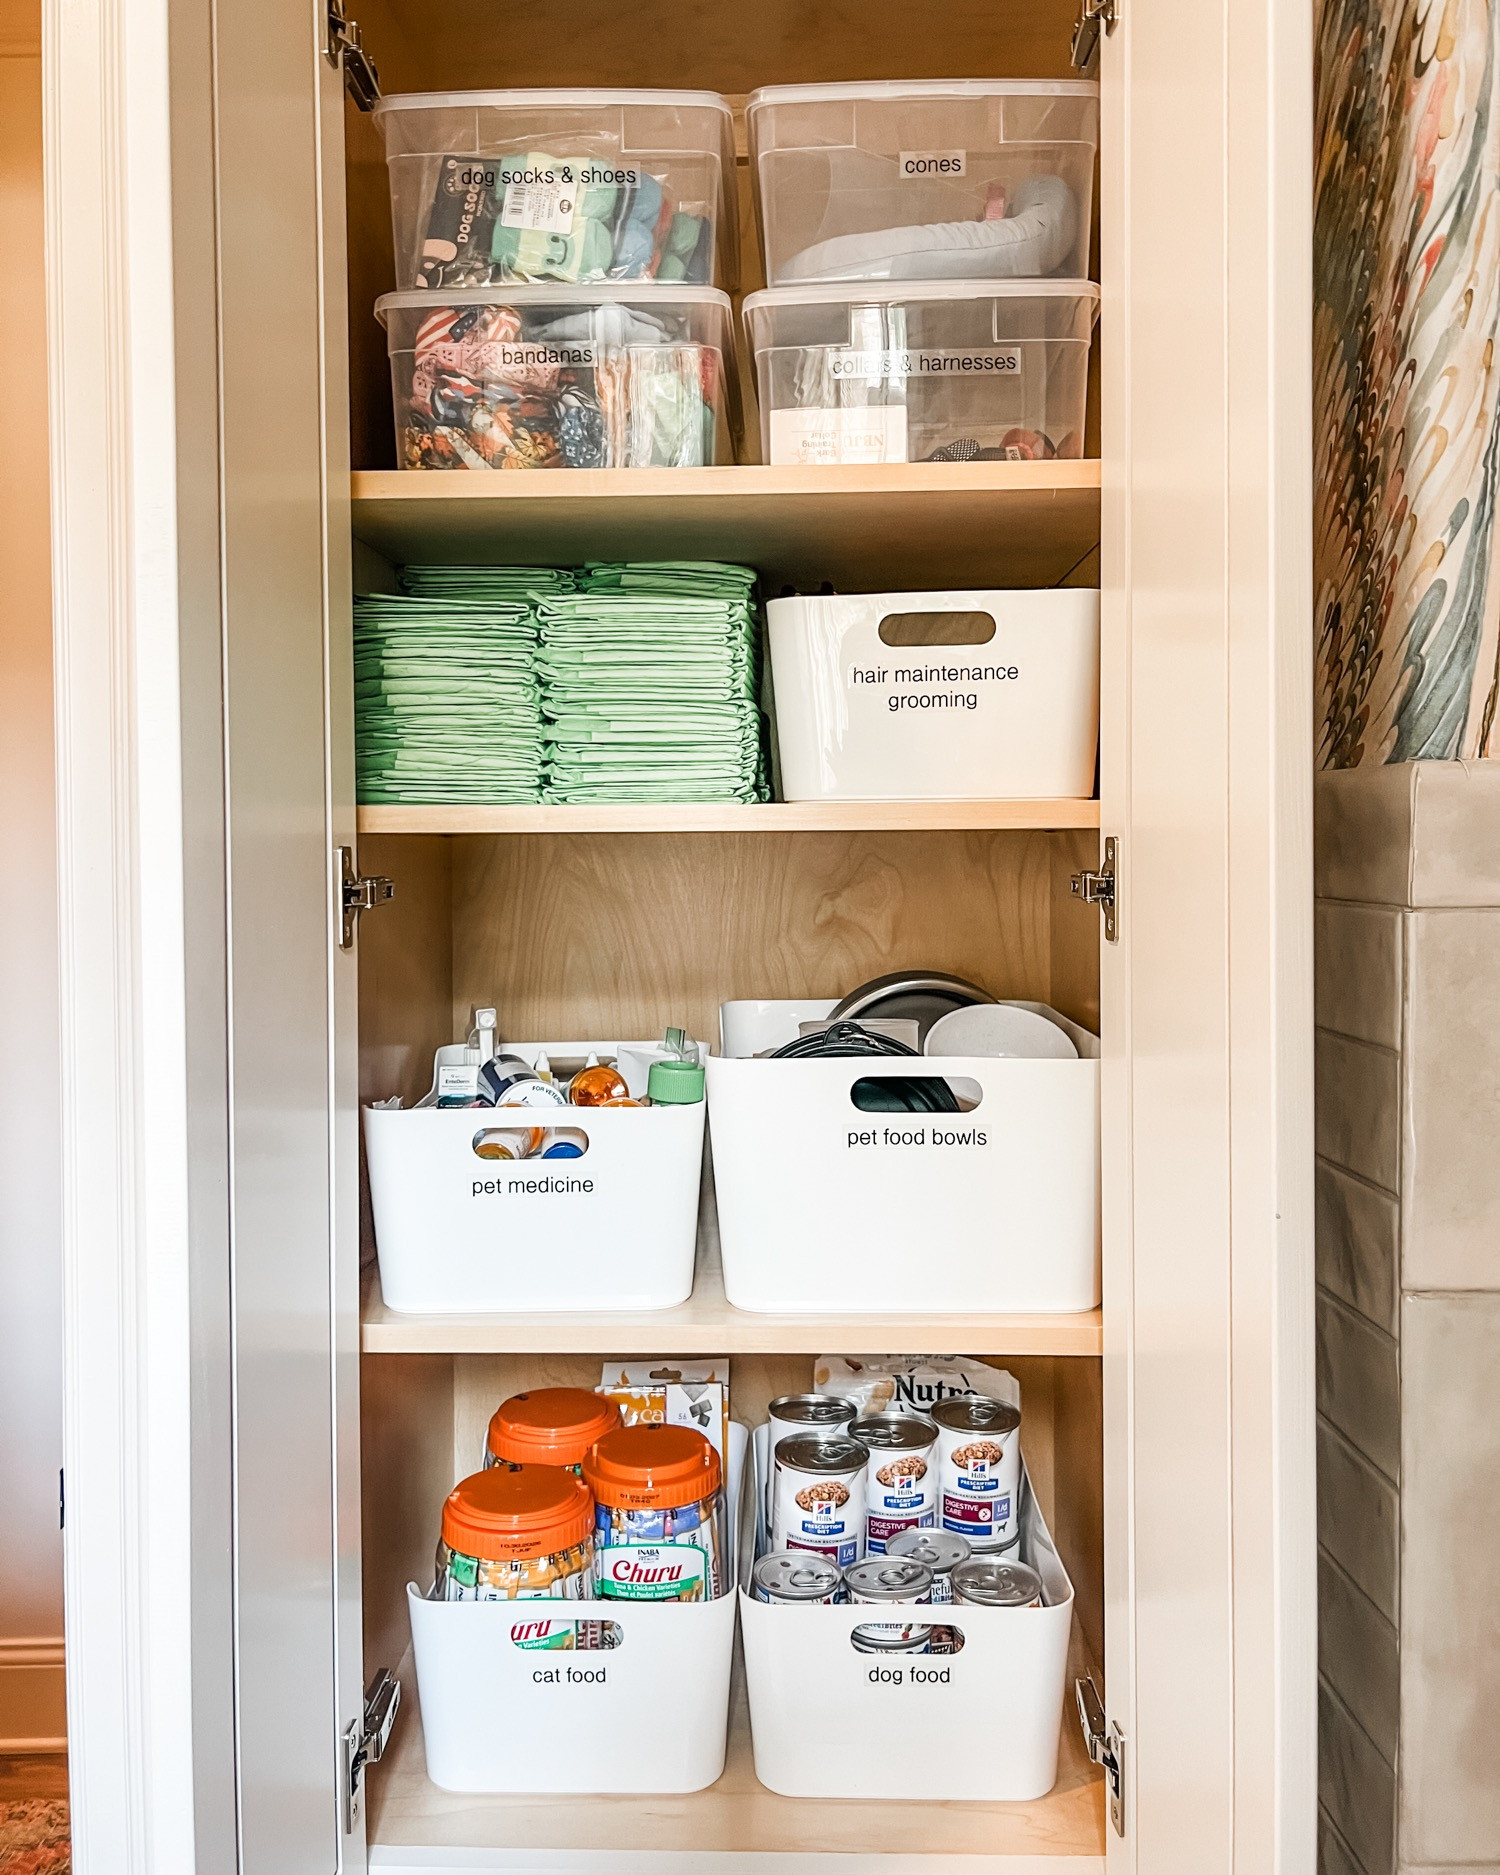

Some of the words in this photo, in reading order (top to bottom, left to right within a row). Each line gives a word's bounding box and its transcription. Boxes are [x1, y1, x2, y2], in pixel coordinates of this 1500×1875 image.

[905, 158, 961, 173] cones
[461, 167, 495, 187] dog
[501, 167, 554, 184] socks
[561, 166, 573, 183] &
[581, 167, 636, 184] shoes
[457, 214, 474, 243] DOG
[502, 347, 593, 364] bandanas
[901, 354, 913, 372] &
[919, 354, 1017, 372] harnesses
[853, 666, 888, 683] hair
[895, 665, 1019, 682] maintenance
[888, 691, 977, 711] grooming
[848, 1129, 877, 1148] pet
[883, 1128, 925, 1145] food
[932, 1128, 987, 1145] bowls
[472, 1178, 501, 1197] pet
[508, 1176, 594, 1193] medicine
[945, 1499, 979, 1511] DIGESTIVE
[945, 1506, 962, 1516] CARE
[870, 1520, 907, 1529] DIGESTIVE
[870, 1528, 889, 1536] CARE
[637, 1548, 660, 1556] INABA
[612, 1560, 683, 1583] Churu
[656, 1582, 681, 1590] Varieties
[511, 1619, 552, 1641] uru
[523, 1638, 550, 1649] Varieties
[532, 1668, 560, 1683] cat
[566, 1667, 606, 1683] food
[868, 1666, 903, 1685] dog
[909, 1666, 950, 1683] food
